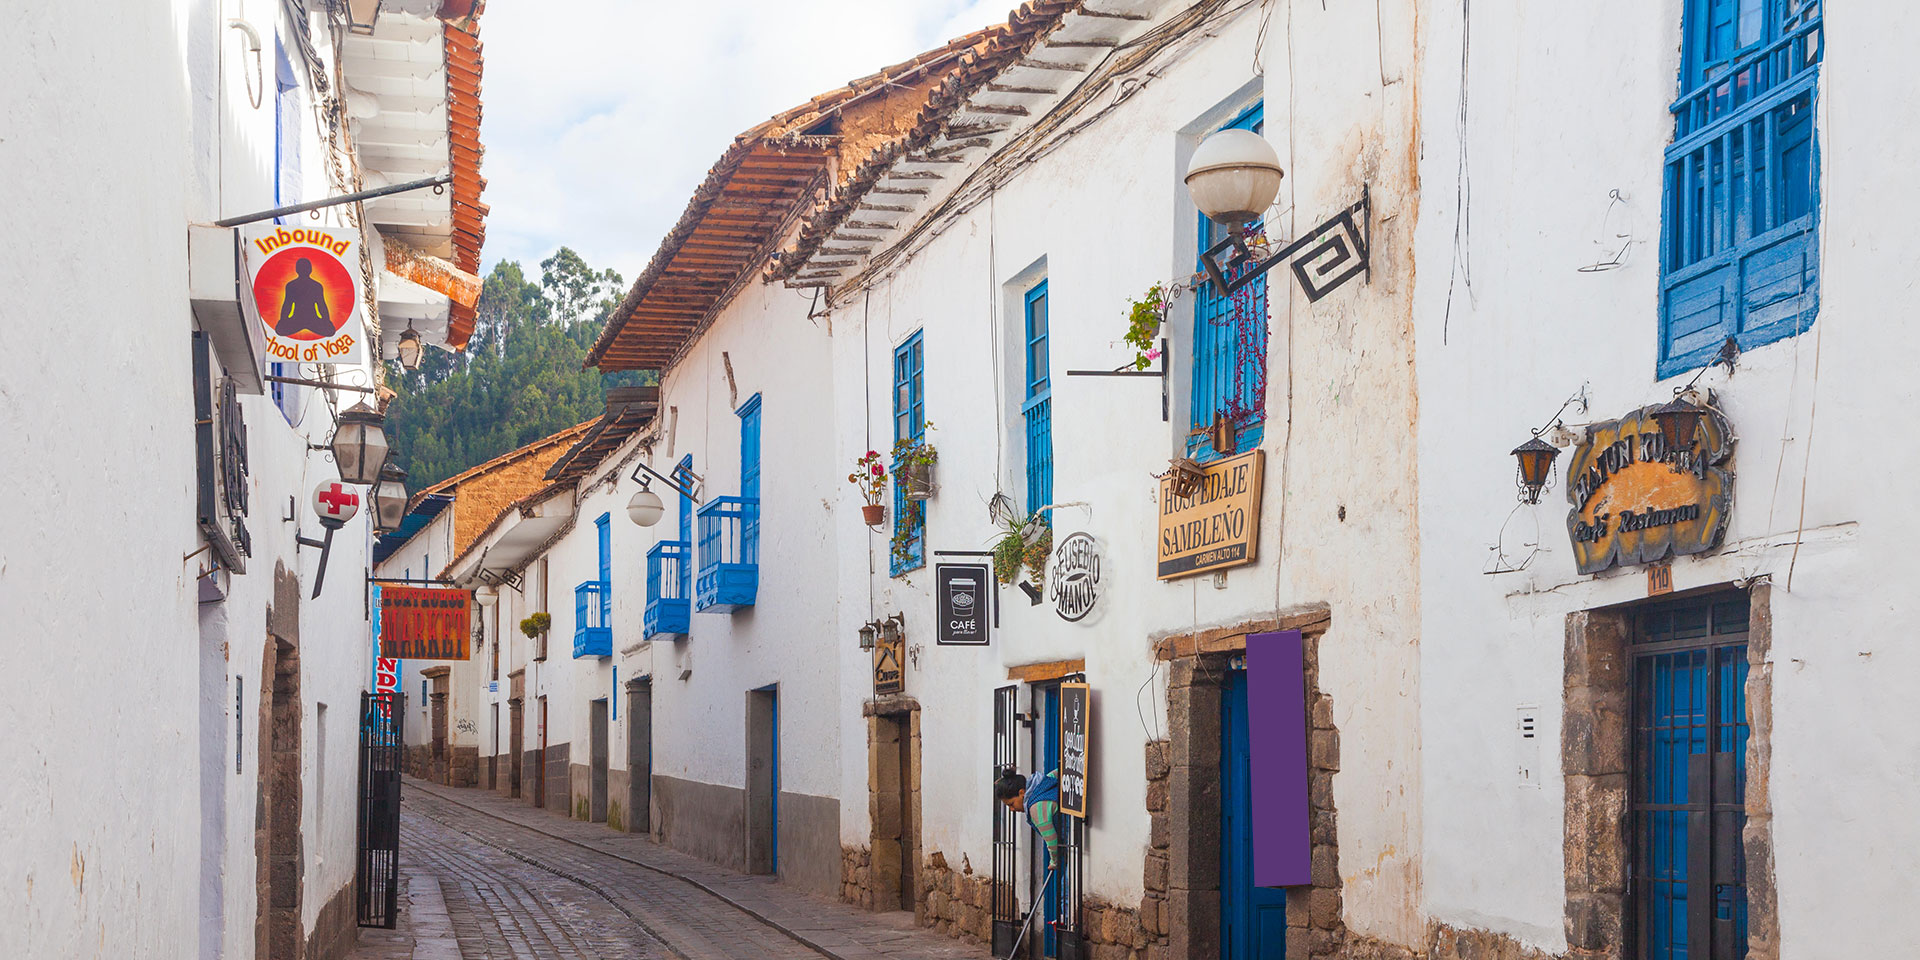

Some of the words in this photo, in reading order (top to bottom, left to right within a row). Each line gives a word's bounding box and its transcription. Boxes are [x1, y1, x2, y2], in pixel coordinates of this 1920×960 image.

[254, 227, 351, 257] Inbound
[303, 344, 318, 361] of
[320, 333, 355, 358] Yoga
[1574, 434, 1634, 513] HATUN
[1162, 505, 1244, 556] SAMBLEÑO
[1575, 513, 1609, 543] Café
[1057, 539, 1100, 585] EUSEBIO
[1195, 551, 1216, 566] CARMEN
[1217, 548, 1230, 560] ALTO
[1231, 547, 1240, 558] 114
[1651, 568, 1669, 592] 110
[383, 609, 465, 658] MARKET
[950, 619, 976, 630] CAFÉ
